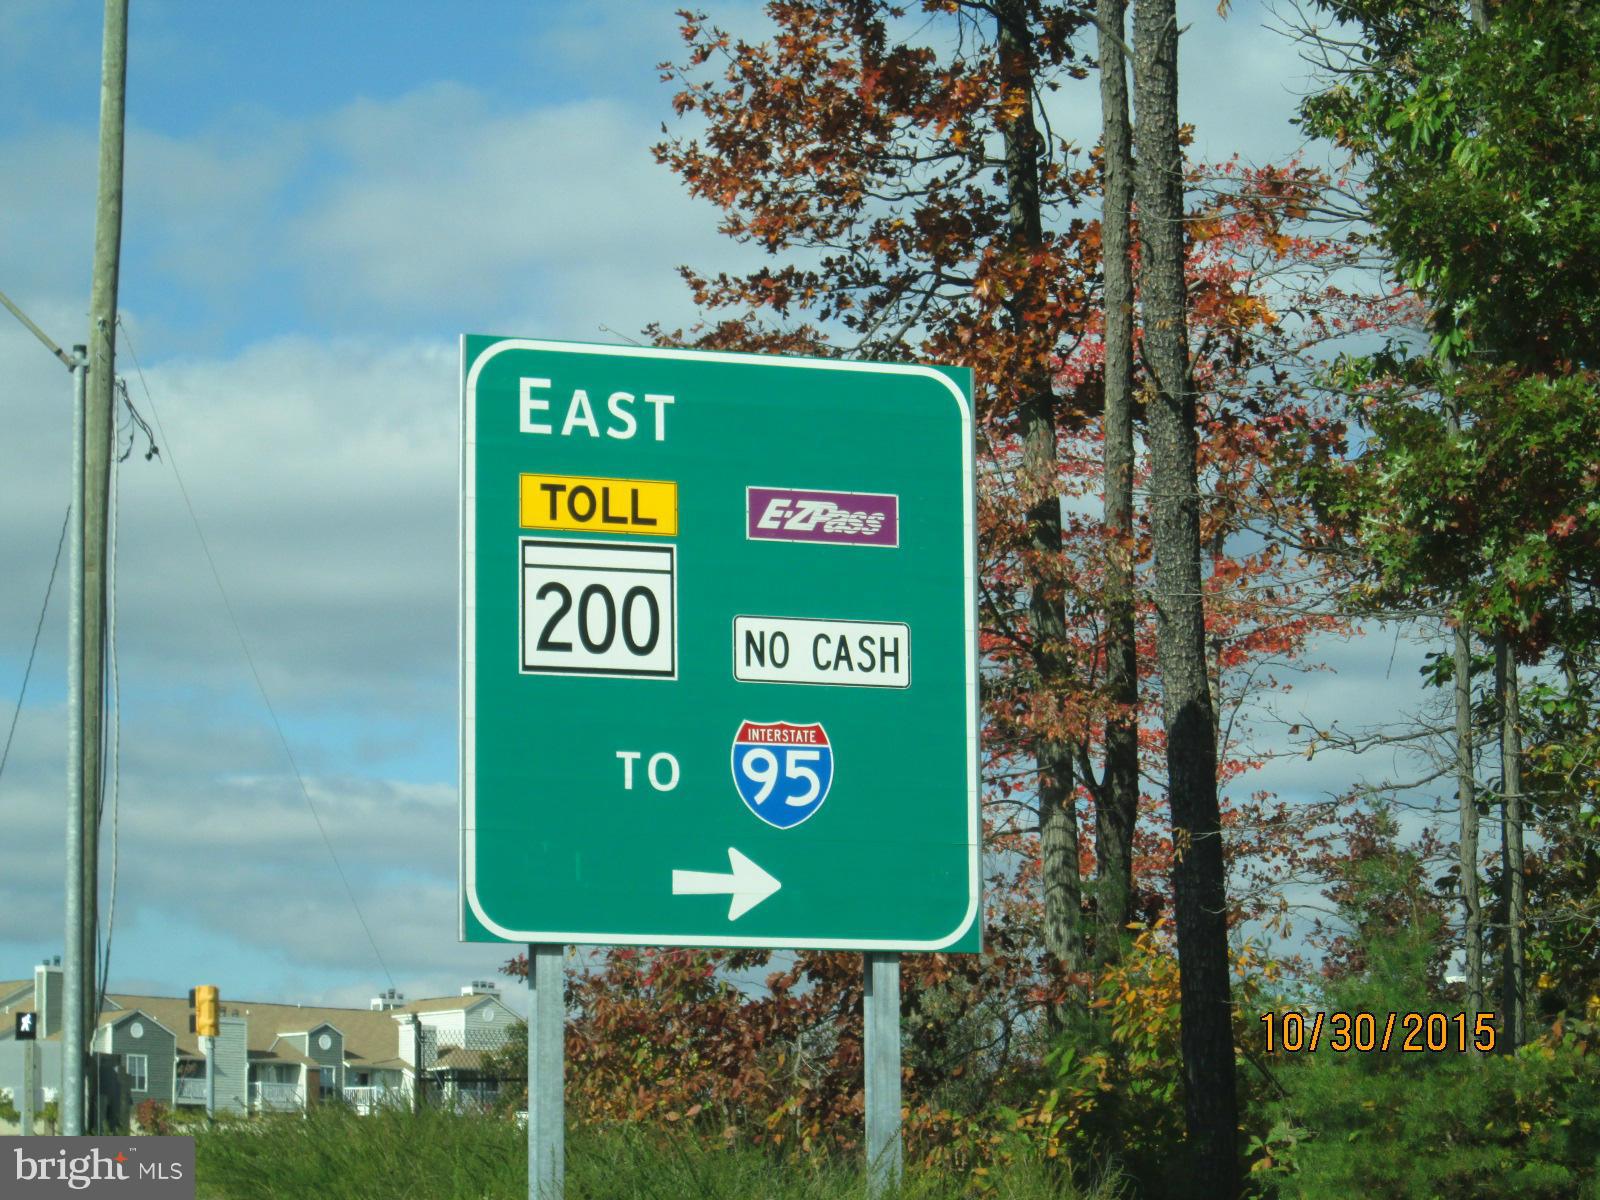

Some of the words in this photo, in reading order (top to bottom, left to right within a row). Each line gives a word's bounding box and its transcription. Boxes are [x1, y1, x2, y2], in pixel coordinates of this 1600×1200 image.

[519, 377, 675, 442] EAST
[540, 483, 657, 527] TOLL
[535, 581, 661, 657] 200
[744, 630, 790, 669] NO
[812, 633, 900, 674] CASH
[748, 728, 816, 743] INTERSTATE
[615, 750, 681, 792] TO
[741, 747, 820, 807] 95
